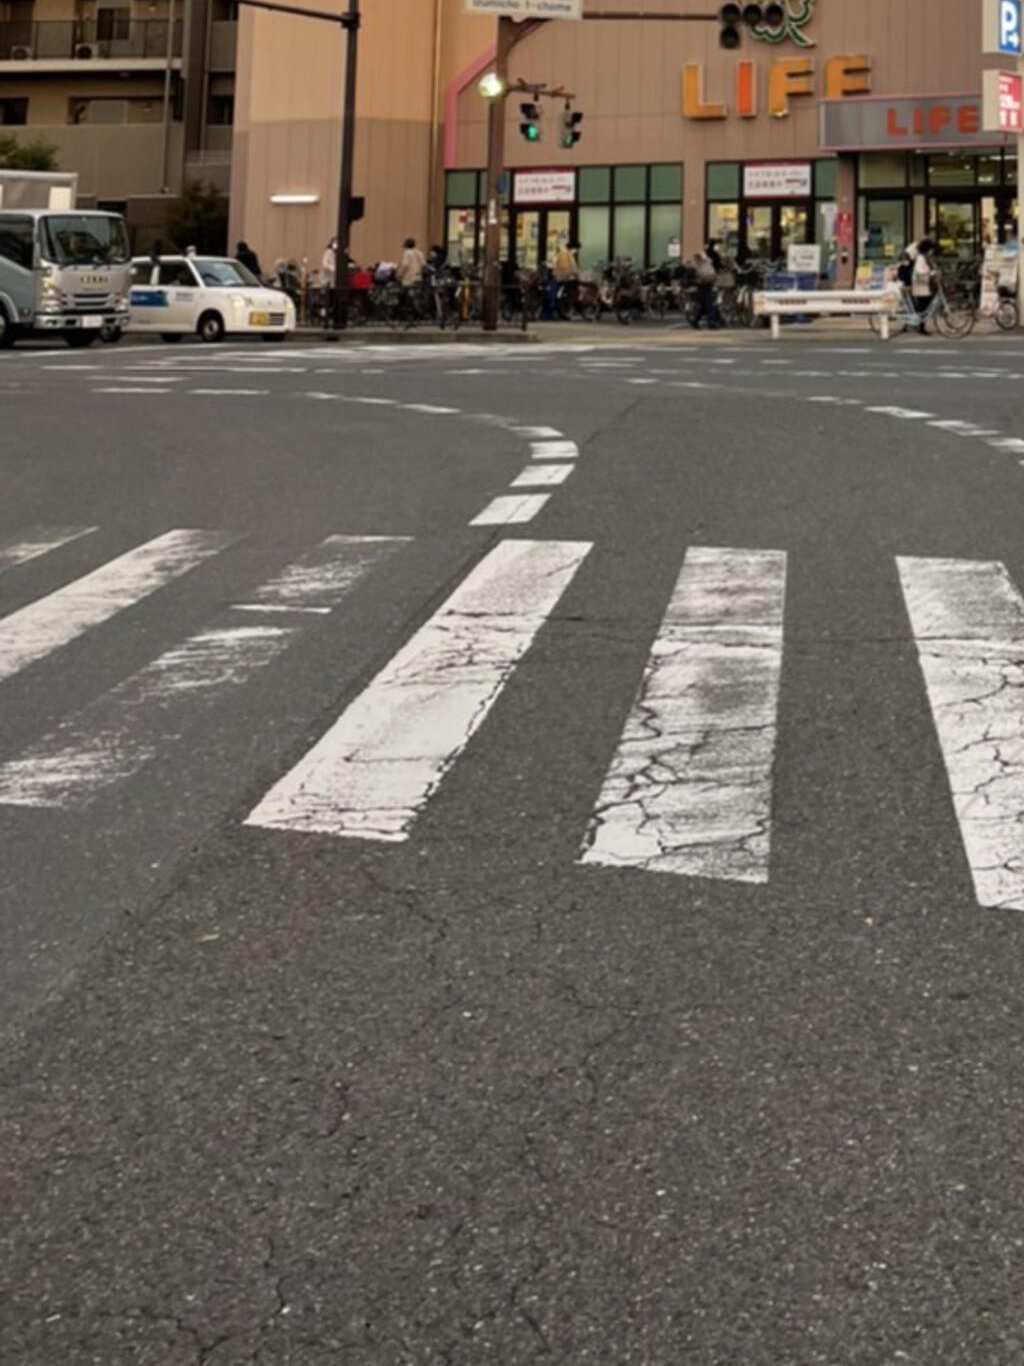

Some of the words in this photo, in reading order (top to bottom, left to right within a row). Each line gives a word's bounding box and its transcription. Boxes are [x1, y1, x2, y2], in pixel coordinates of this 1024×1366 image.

[1001, 0, 1018, 46] P
[683, 56, 871, 120] LIFE
[886, 105, 978, 136] LIFE
